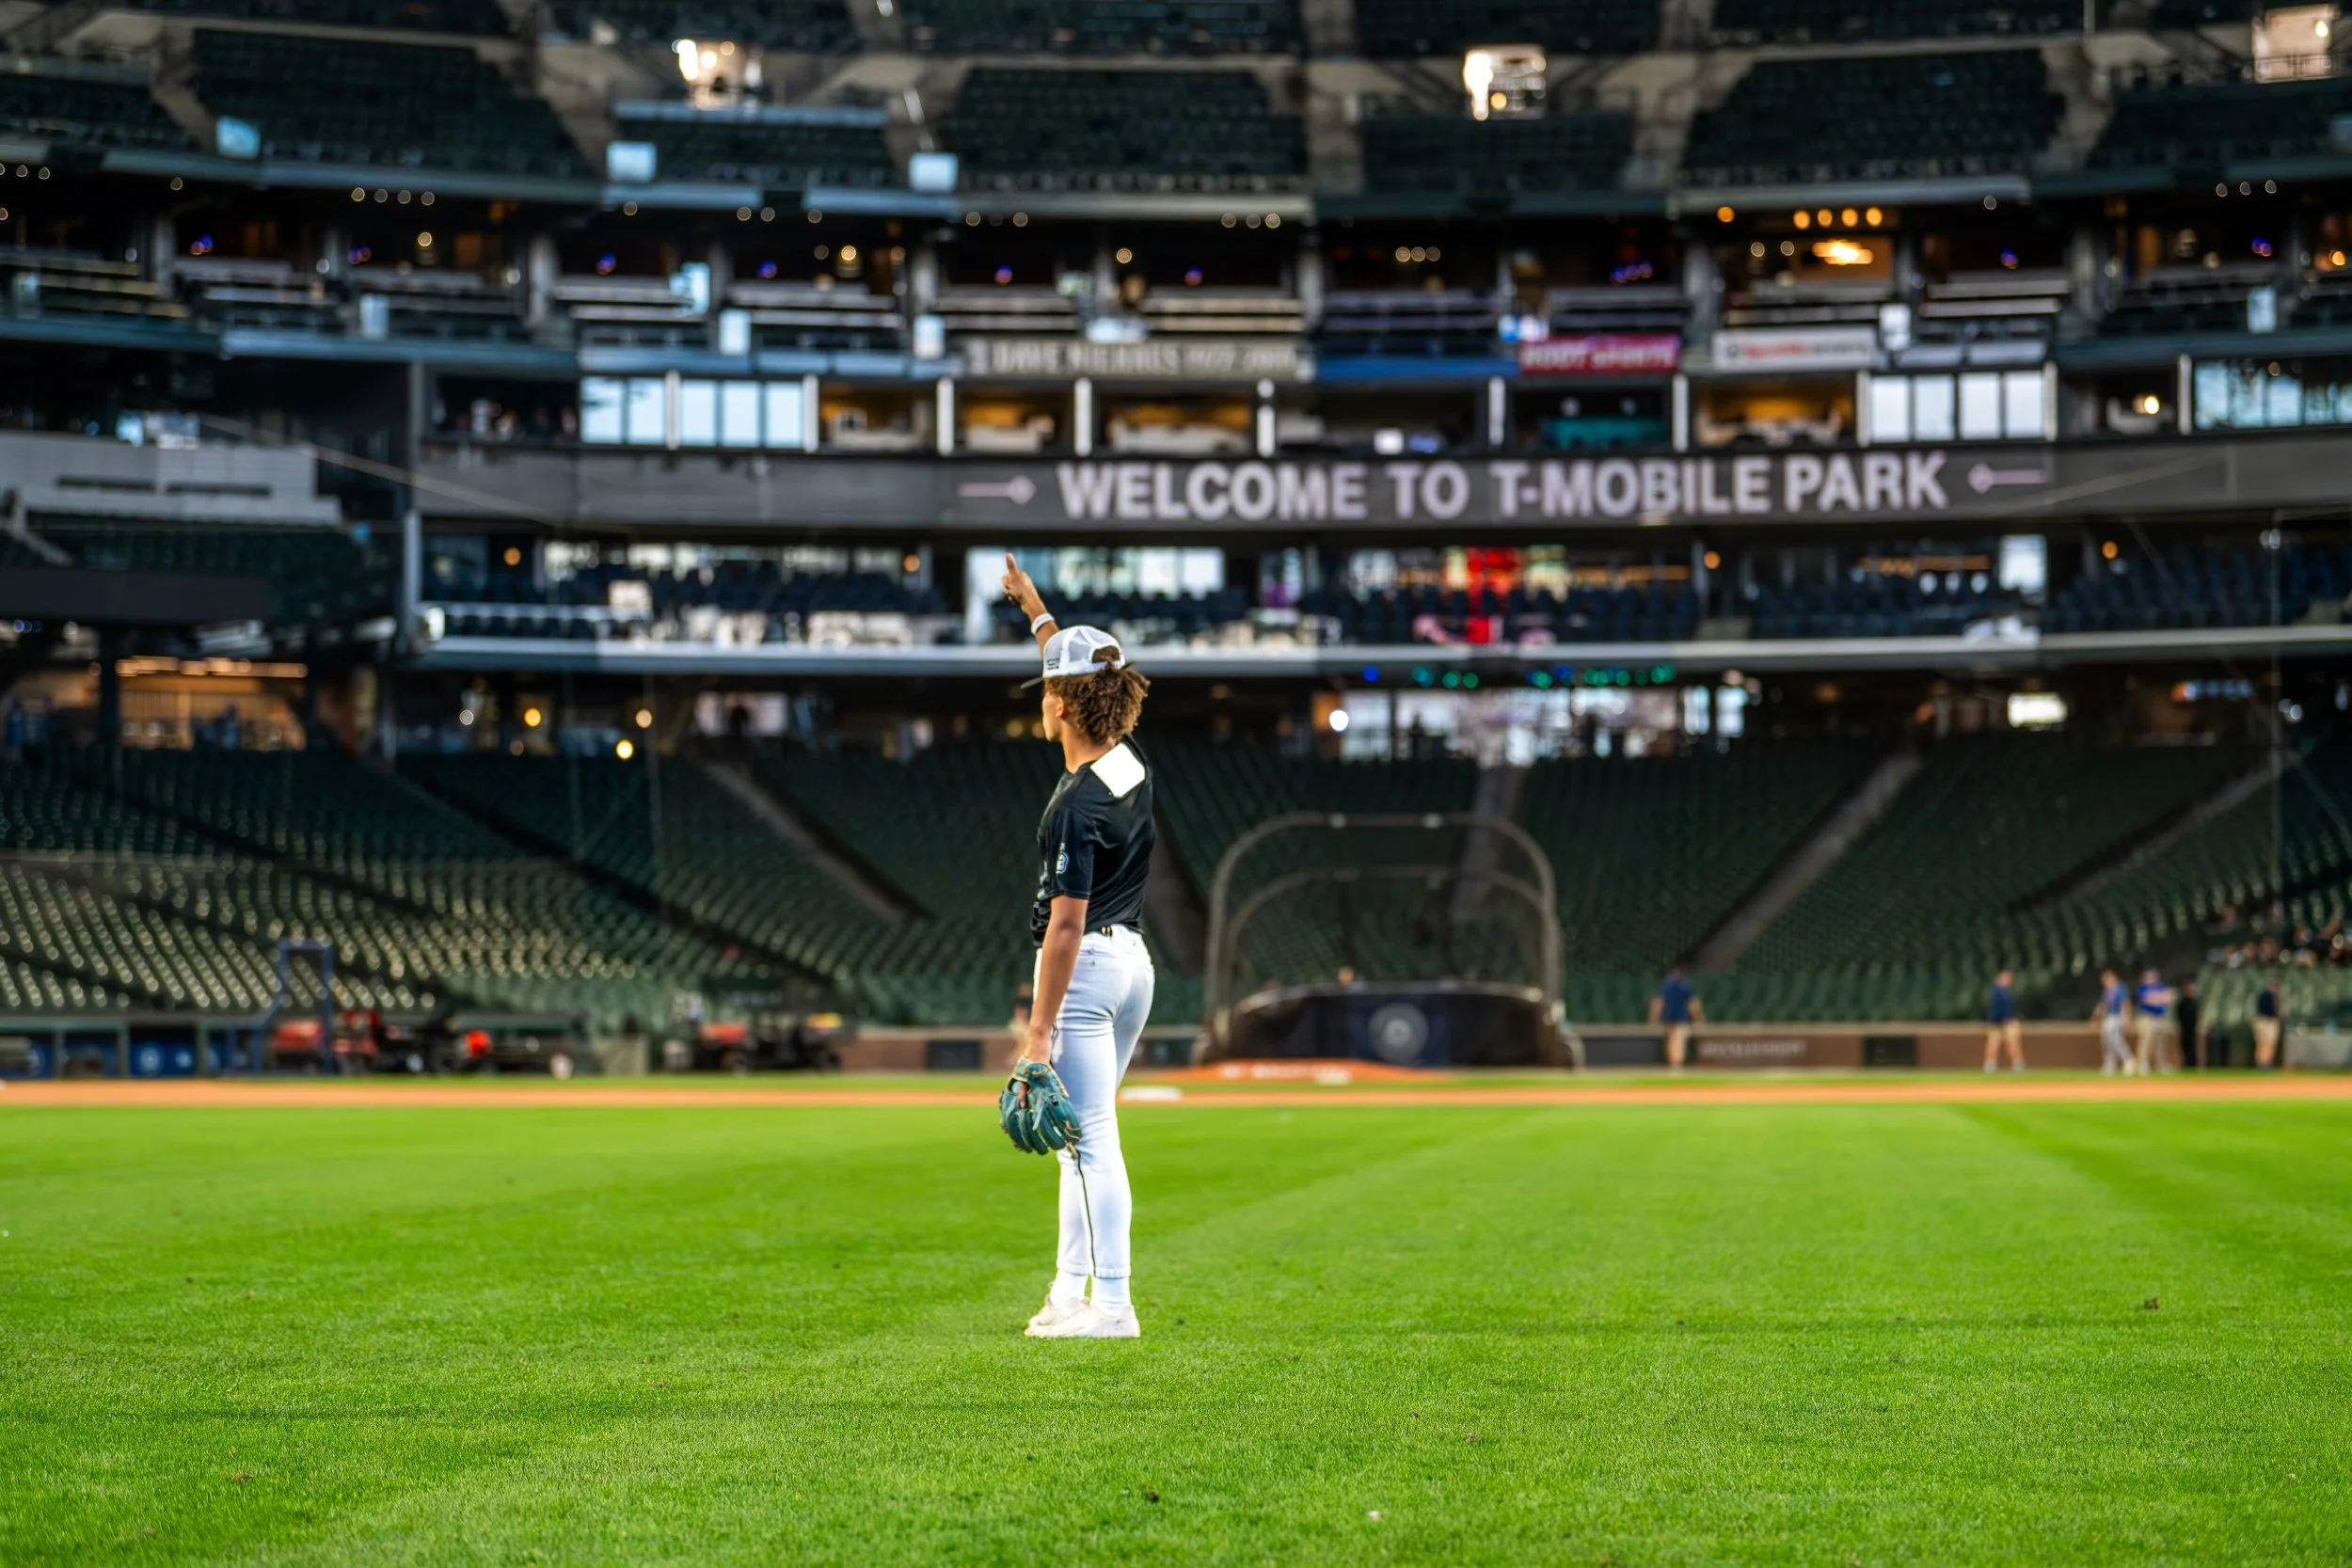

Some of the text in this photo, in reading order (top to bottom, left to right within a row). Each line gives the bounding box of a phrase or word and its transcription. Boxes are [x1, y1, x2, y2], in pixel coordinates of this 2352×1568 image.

[1058, 453, 1947, 520] WELCOME TO T-MOBILE PARK
